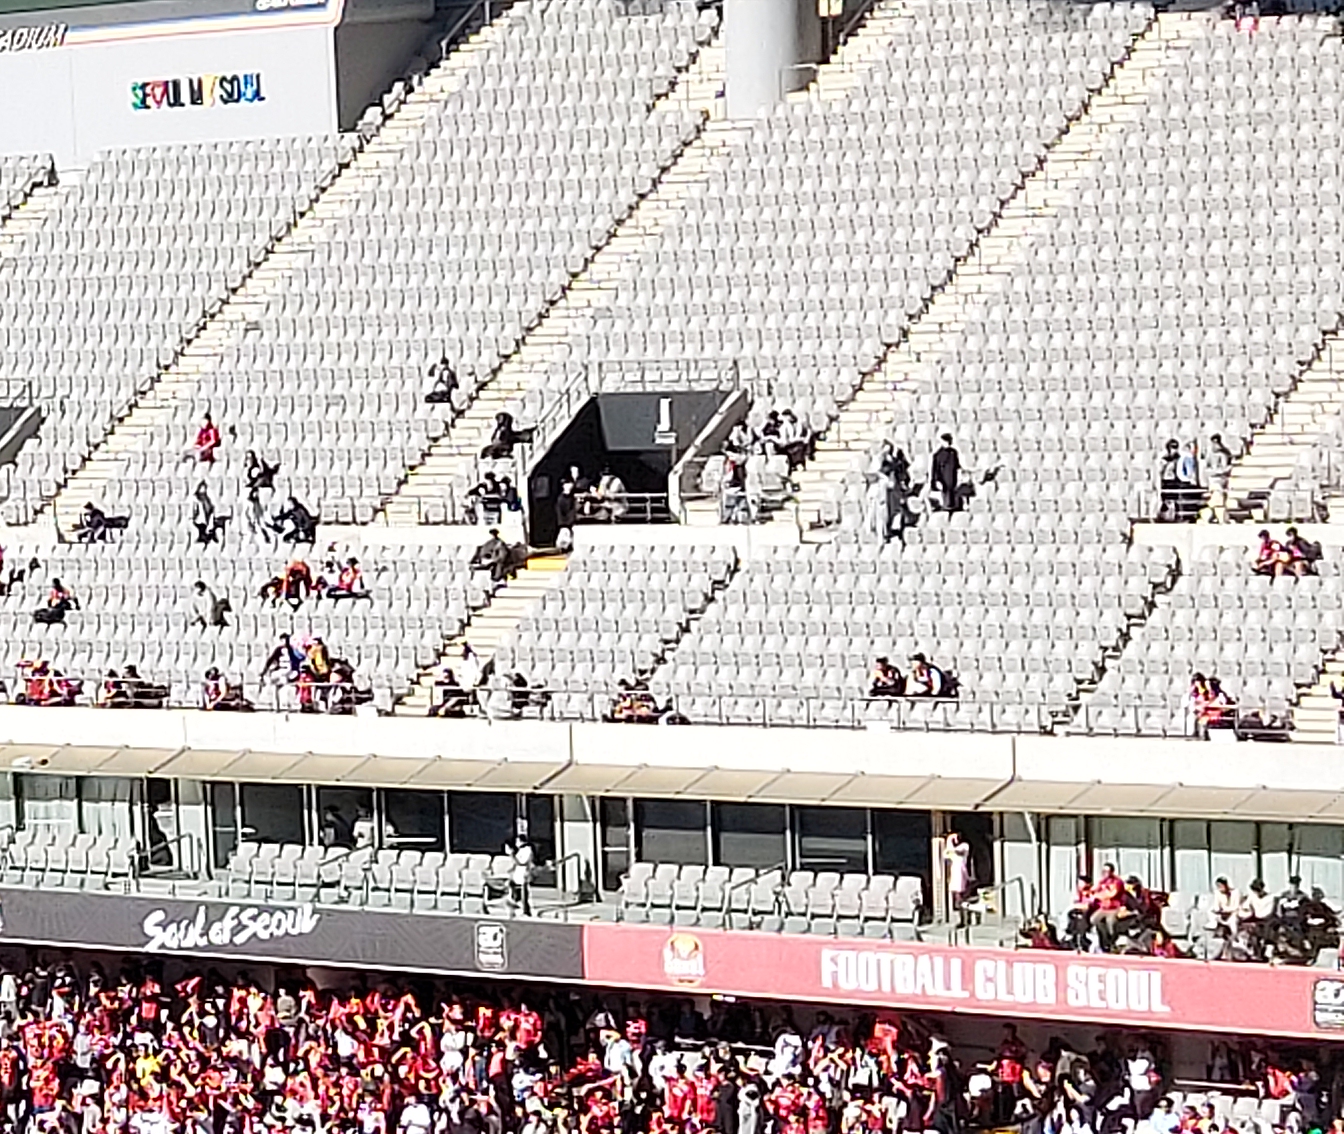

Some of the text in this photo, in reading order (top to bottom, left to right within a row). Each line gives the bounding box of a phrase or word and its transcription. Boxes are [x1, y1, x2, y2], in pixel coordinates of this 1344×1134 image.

[141, 907, 209, 951] Soul
[234, 904, 321, 946] Seoul
[820, 947, 1171, 1014] FOOTBALL CLUB SEOUL
